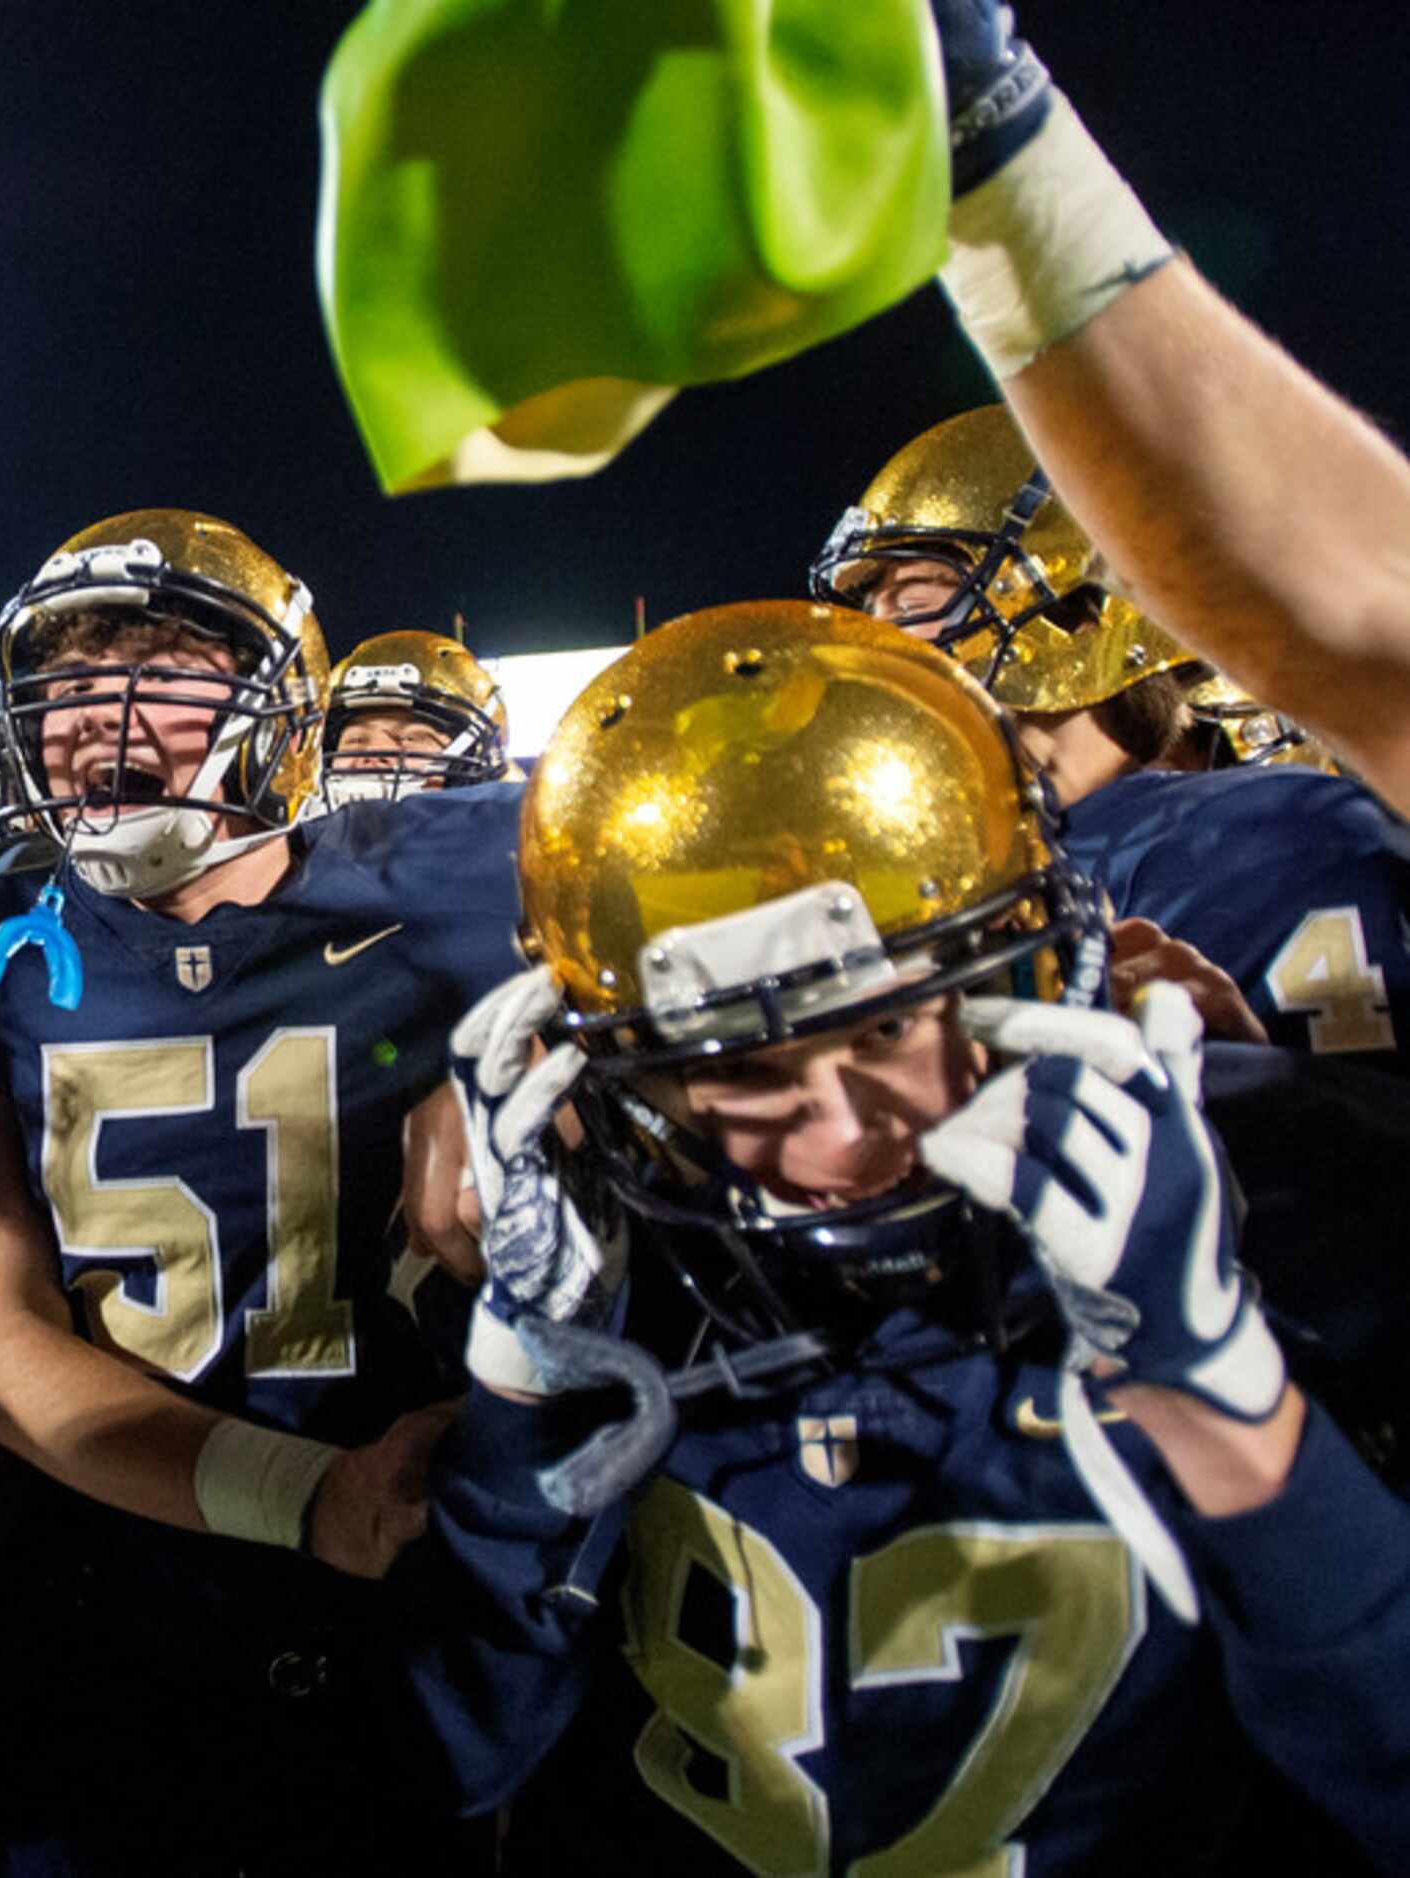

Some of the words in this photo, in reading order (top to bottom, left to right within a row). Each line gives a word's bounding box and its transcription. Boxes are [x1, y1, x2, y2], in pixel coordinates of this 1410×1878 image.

[1265, 904, 1397, 1054] 4
[40, 1024, 357, 1382] 51
[621, 1475, 1148, 1878] 87
